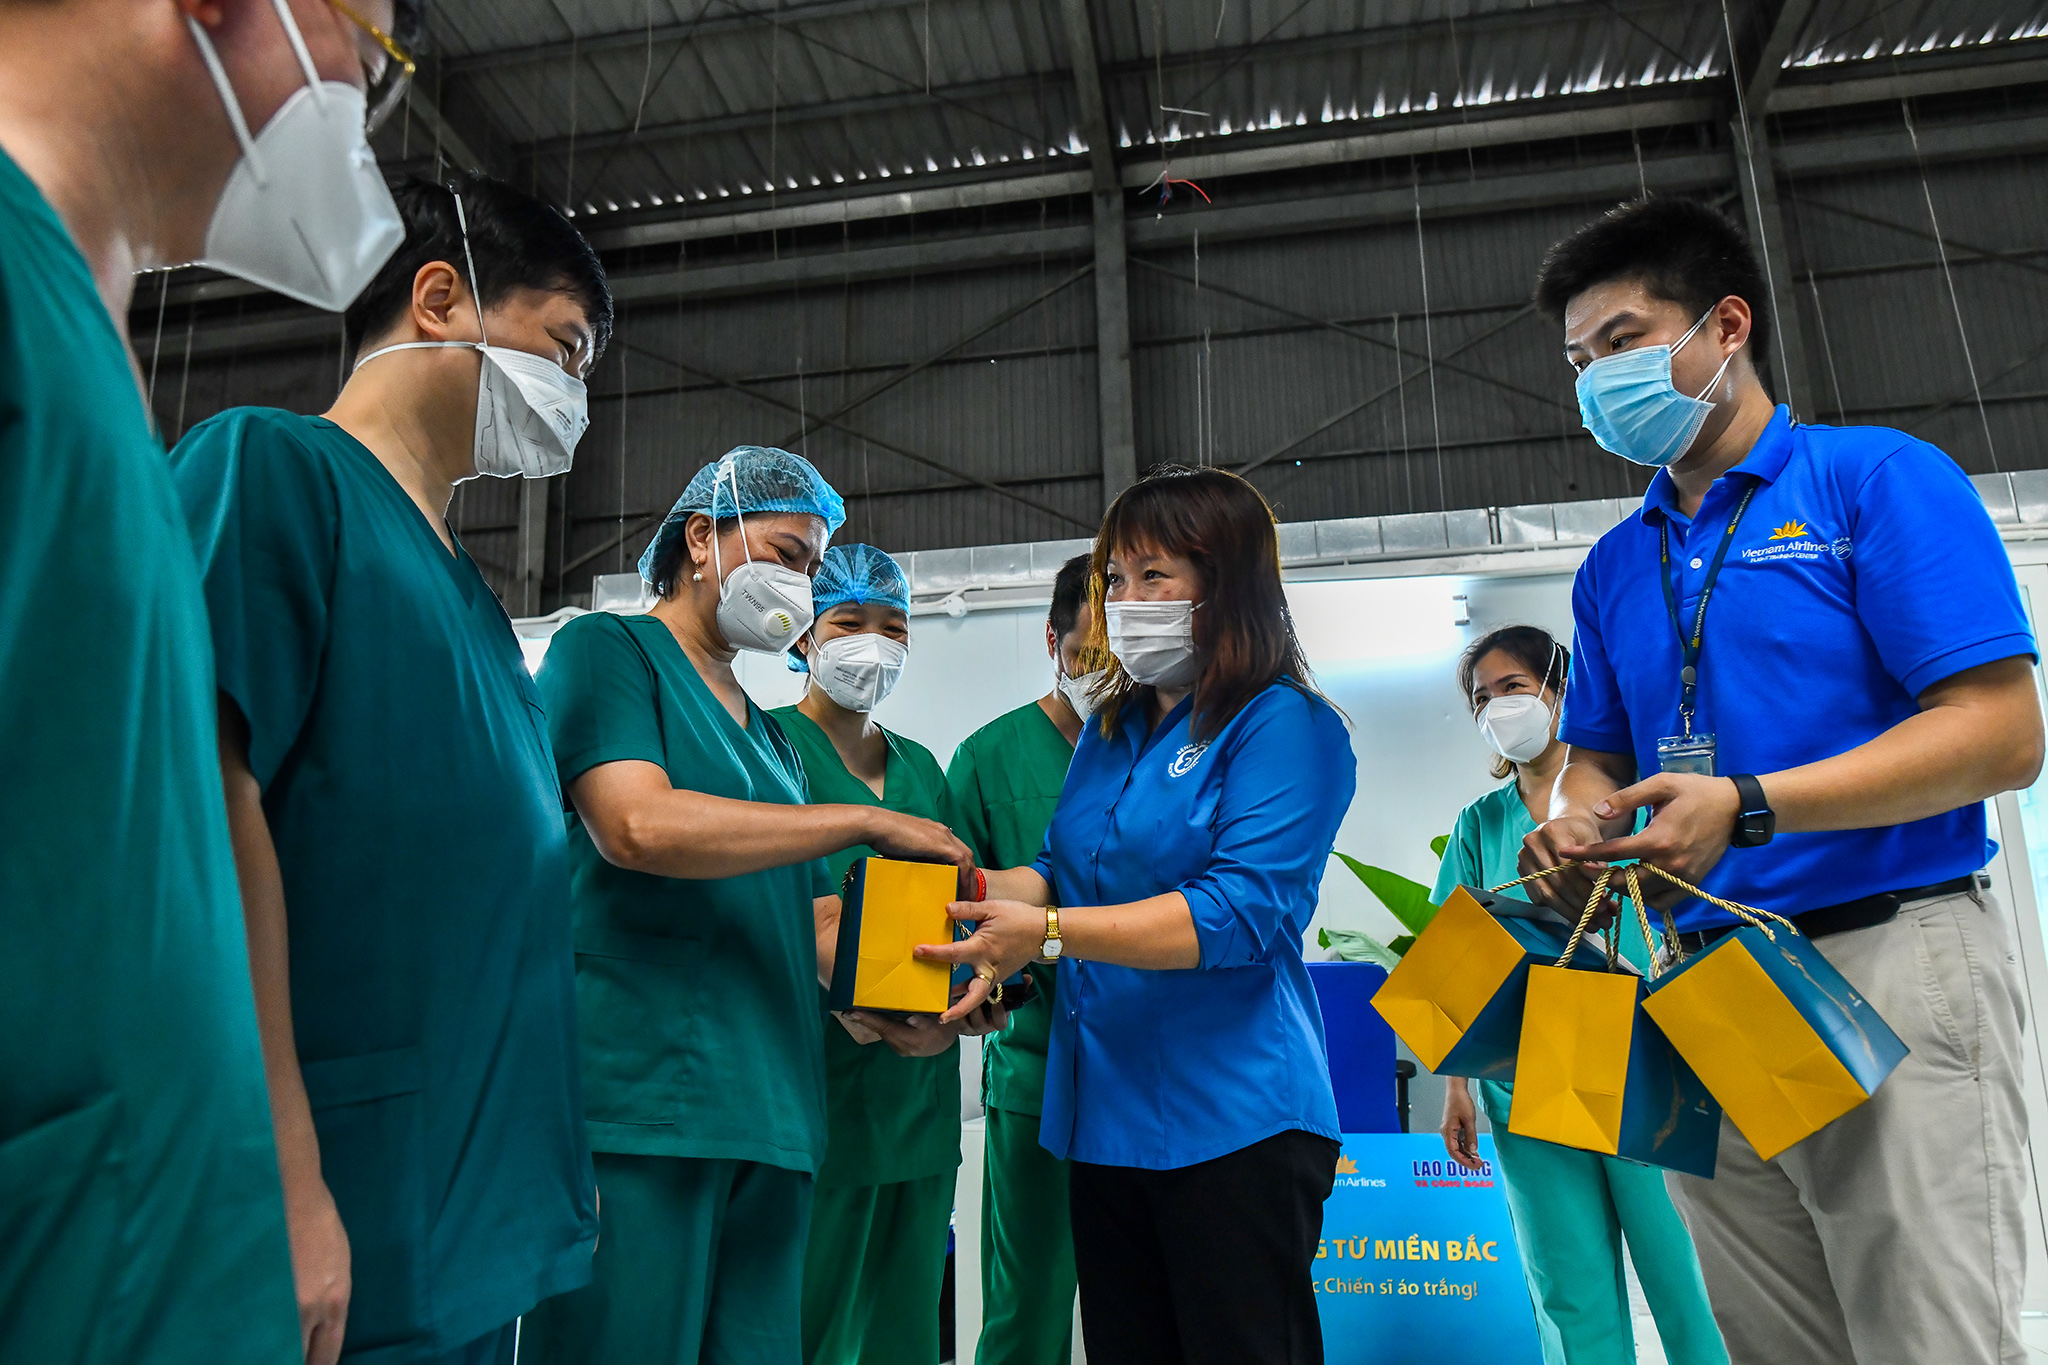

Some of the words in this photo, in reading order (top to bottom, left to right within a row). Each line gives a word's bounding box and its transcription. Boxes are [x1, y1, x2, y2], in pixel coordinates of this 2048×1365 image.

[1742, 544, 1785, 558] Vietnam
[1786, 541, 1830, 552] Airlines
[1413, 1160, 1442, 1177] LAO
[1346, 1177, 1386, 1187] Airlines
[1332, 1235, 1369, 1259] TỪ
[1374, 1233, 1440, 1261] MIỀN
[1446, 1233, 1499, 1262] BẮC
[1324, 1276, 1375, 1294] Chiến
[1379, 1279, 1393, 1295] sĩ
[1397, 1279, 1419, 1295] áo
[1424, 1277, 1478, 1301] trắng!
